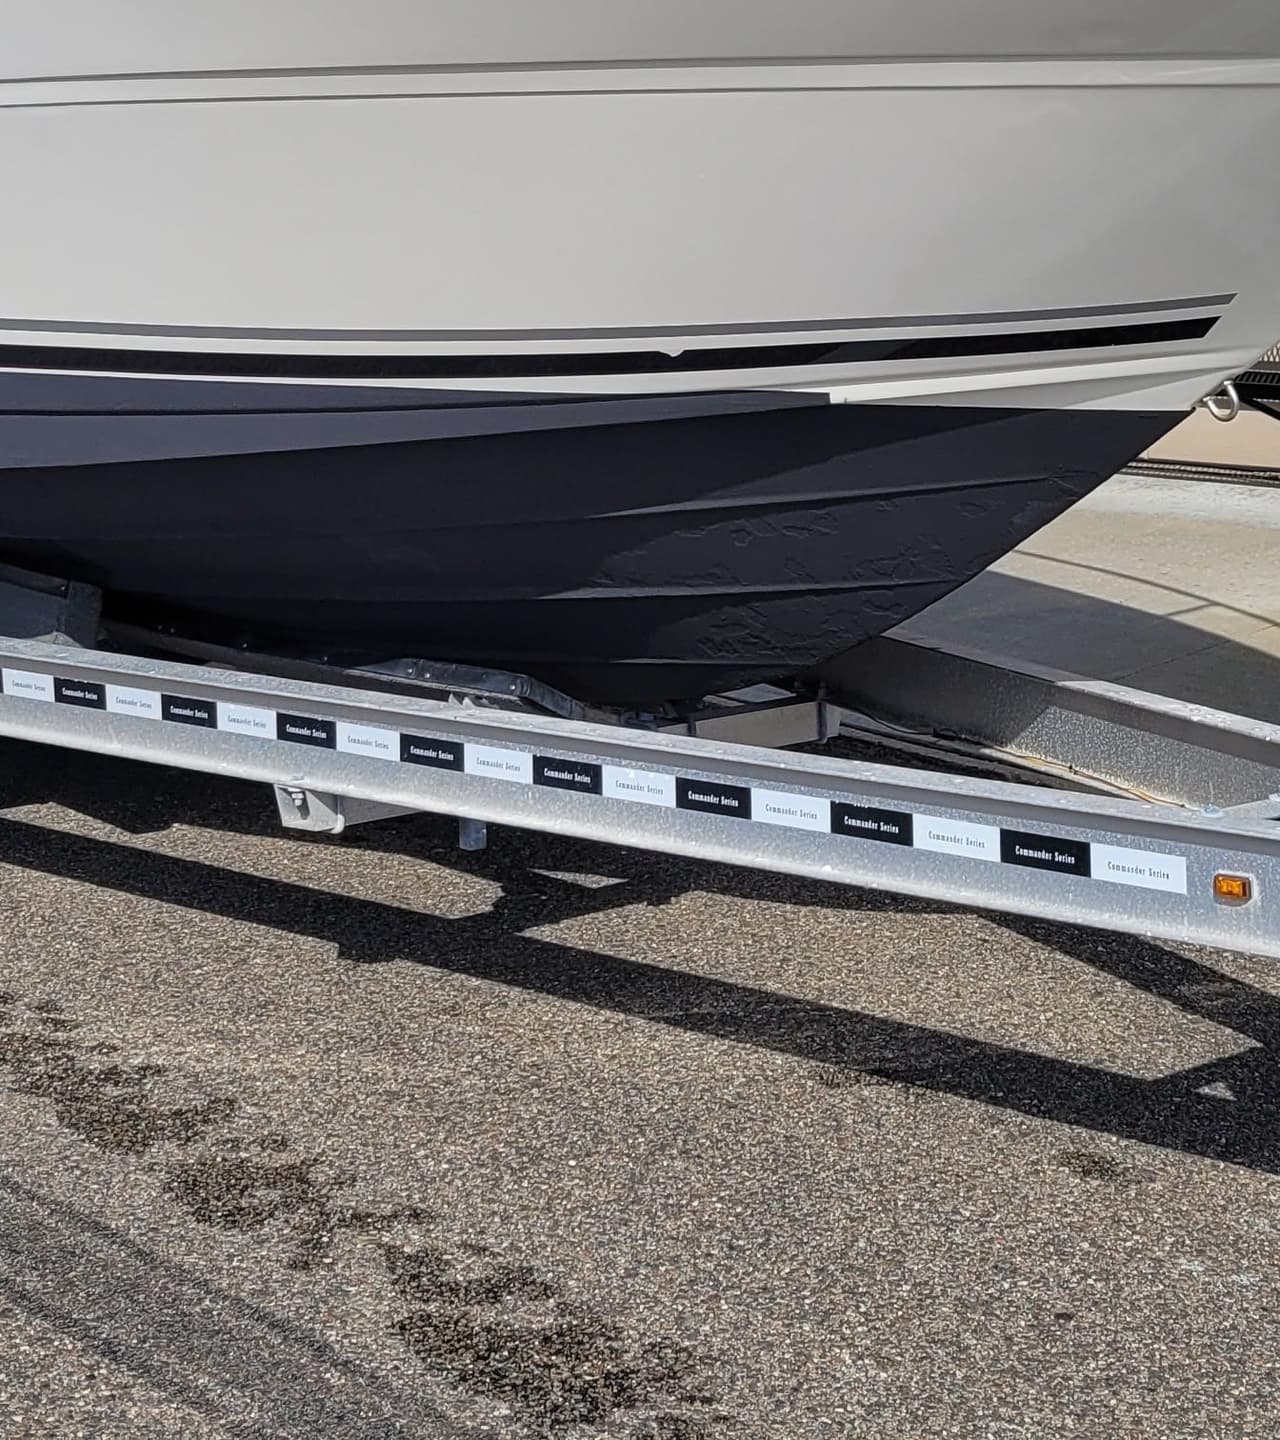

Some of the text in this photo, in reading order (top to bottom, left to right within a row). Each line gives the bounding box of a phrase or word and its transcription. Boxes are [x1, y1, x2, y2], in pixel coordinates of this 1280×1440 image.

[410, 745, 454, 761] Commander Series
[476, 757, 521, 772] Commander Series
[544, 768, 591, 783] Commander Series
[616, 780, 664, 795] Commander Series
[688, 790, 739, 807] Commander Series
[765, 803, 818, 820] Commander Series
[844, 816, 899, 834] Commander Series
[928, 830, 985, 848] Commander Series
[1015, 845, 1075, 864] Commander Series
[1107, 861, 1170, 880] Commander Series
